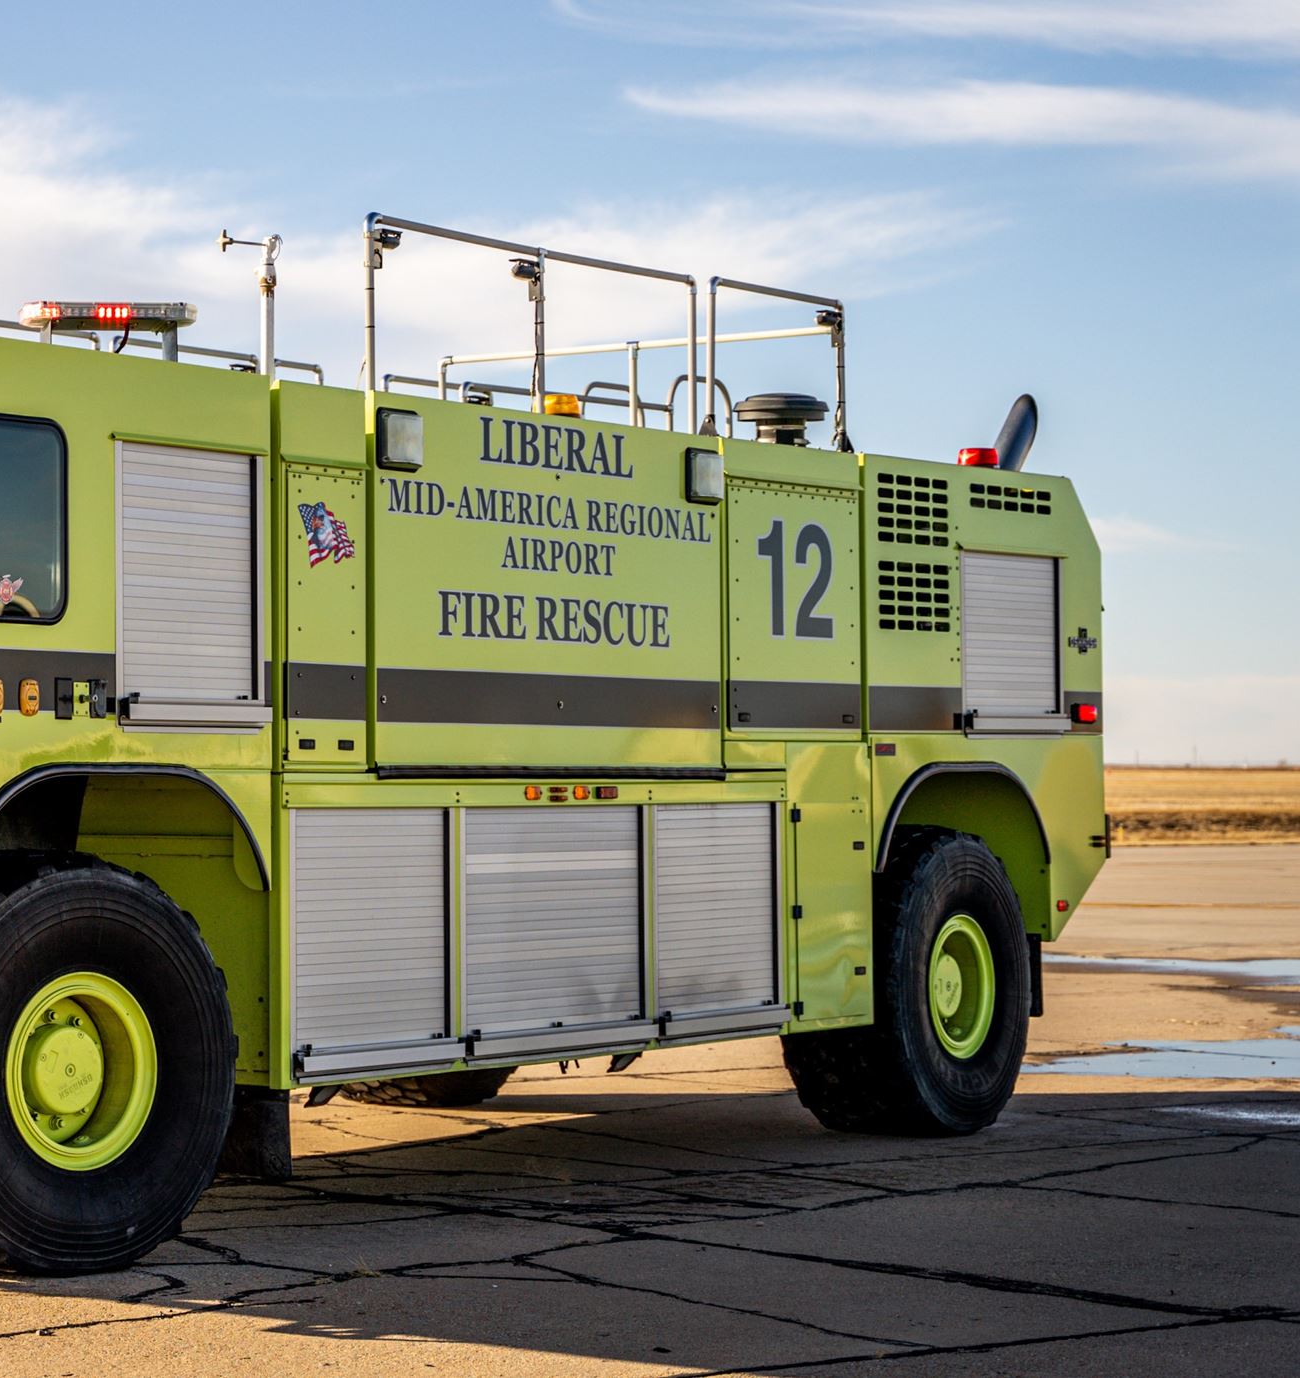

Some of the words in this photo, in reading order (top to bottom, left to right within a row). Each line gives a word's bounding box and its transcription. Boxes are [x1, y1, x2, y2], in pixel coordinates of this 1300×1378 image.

[480, 417, 633, 479] LIBERAL
[388, 478, 579, 530] MID-AMERICA
[586, 499, 711, 543] REGIONAL
[501, 536, 616, 577] AIRPORT
[756, 519, 834, 639] 12
[438, 590, 527, 639] FIRE
[536, 596, 670, 648] RESCUE
